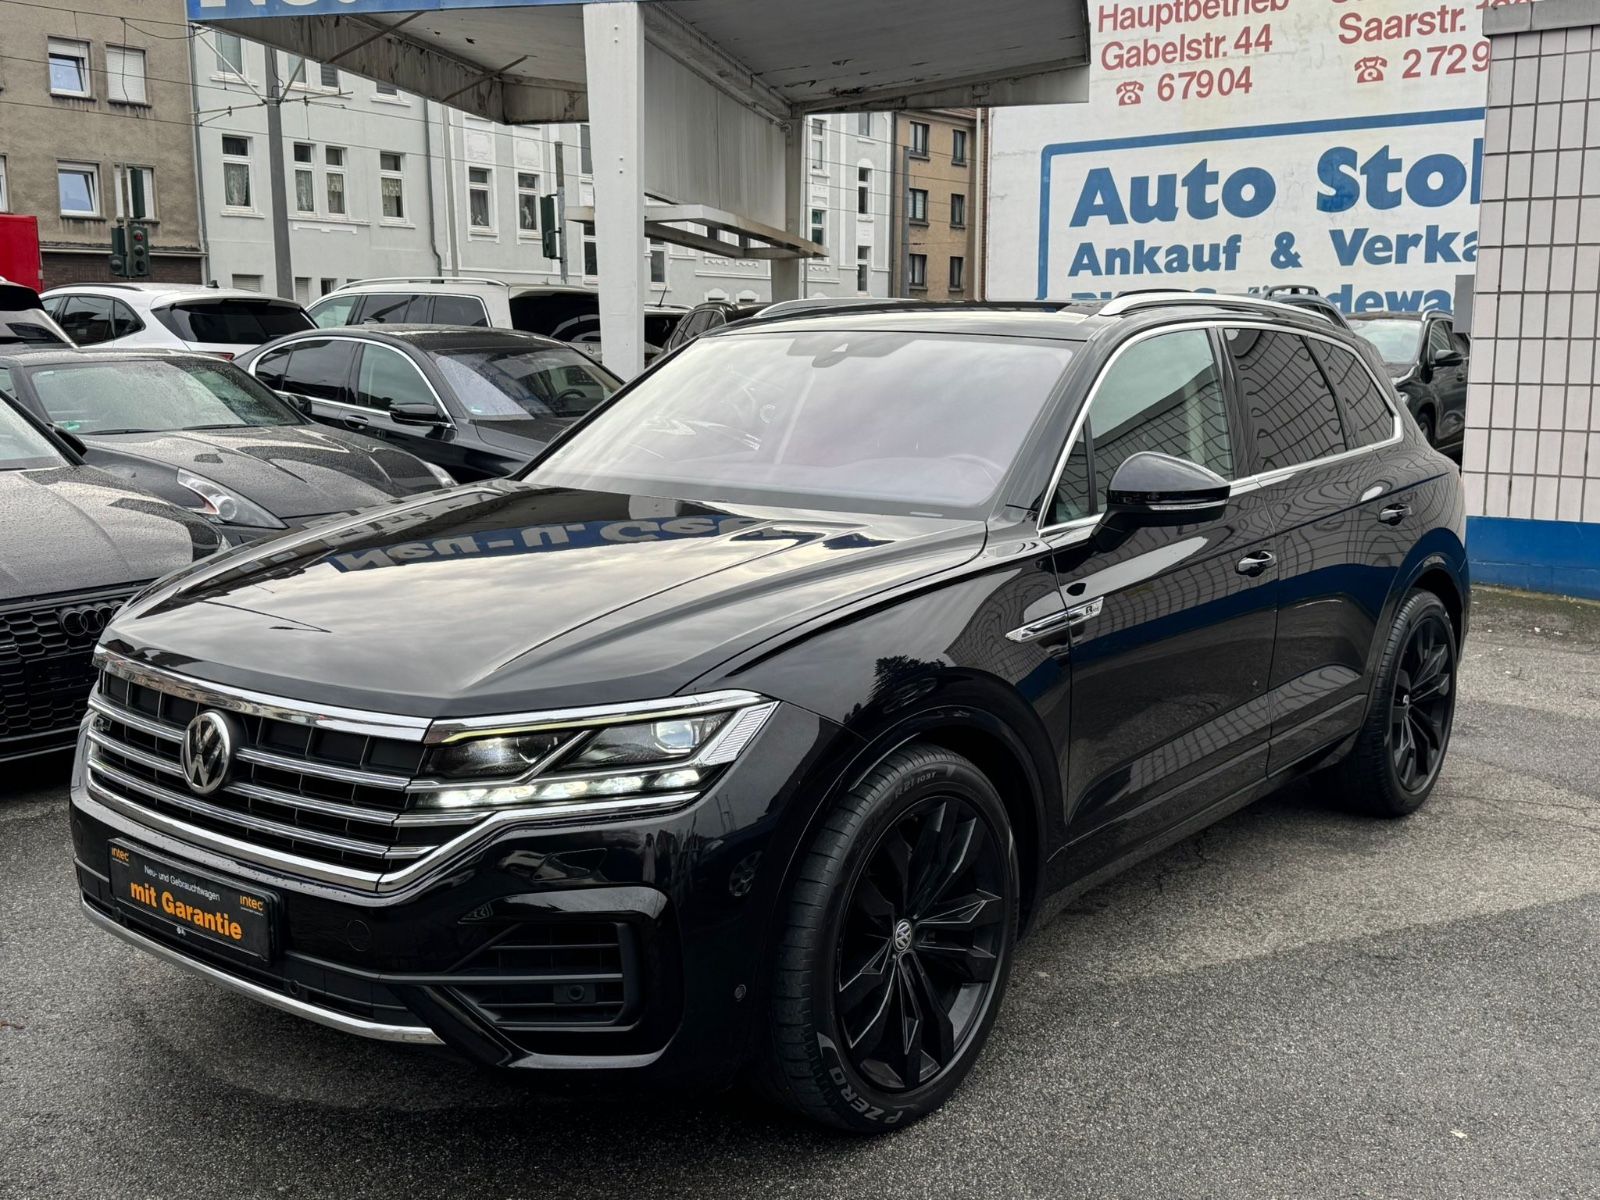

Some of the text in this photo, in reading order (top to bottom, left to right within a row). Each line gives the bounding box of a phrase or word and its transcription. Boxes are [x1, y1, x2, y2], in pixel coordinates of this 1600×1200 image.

[1338, 4, 1467, 45] Saarstr.
[1101, 23, 1273, 71] Gabelstr. 44
[1157, 65, 1253, 102] 67904
[1069, 157, 1276, 228] Auto
[1067, 233, 1242, 277] Ankauf
[1271, 231, 1303, 270] &
[170, 875, 221, 901] Gebrauchtwagen
[240, 895, 264, 911] intec
[130, 881, 243, 940] mit Garantie
